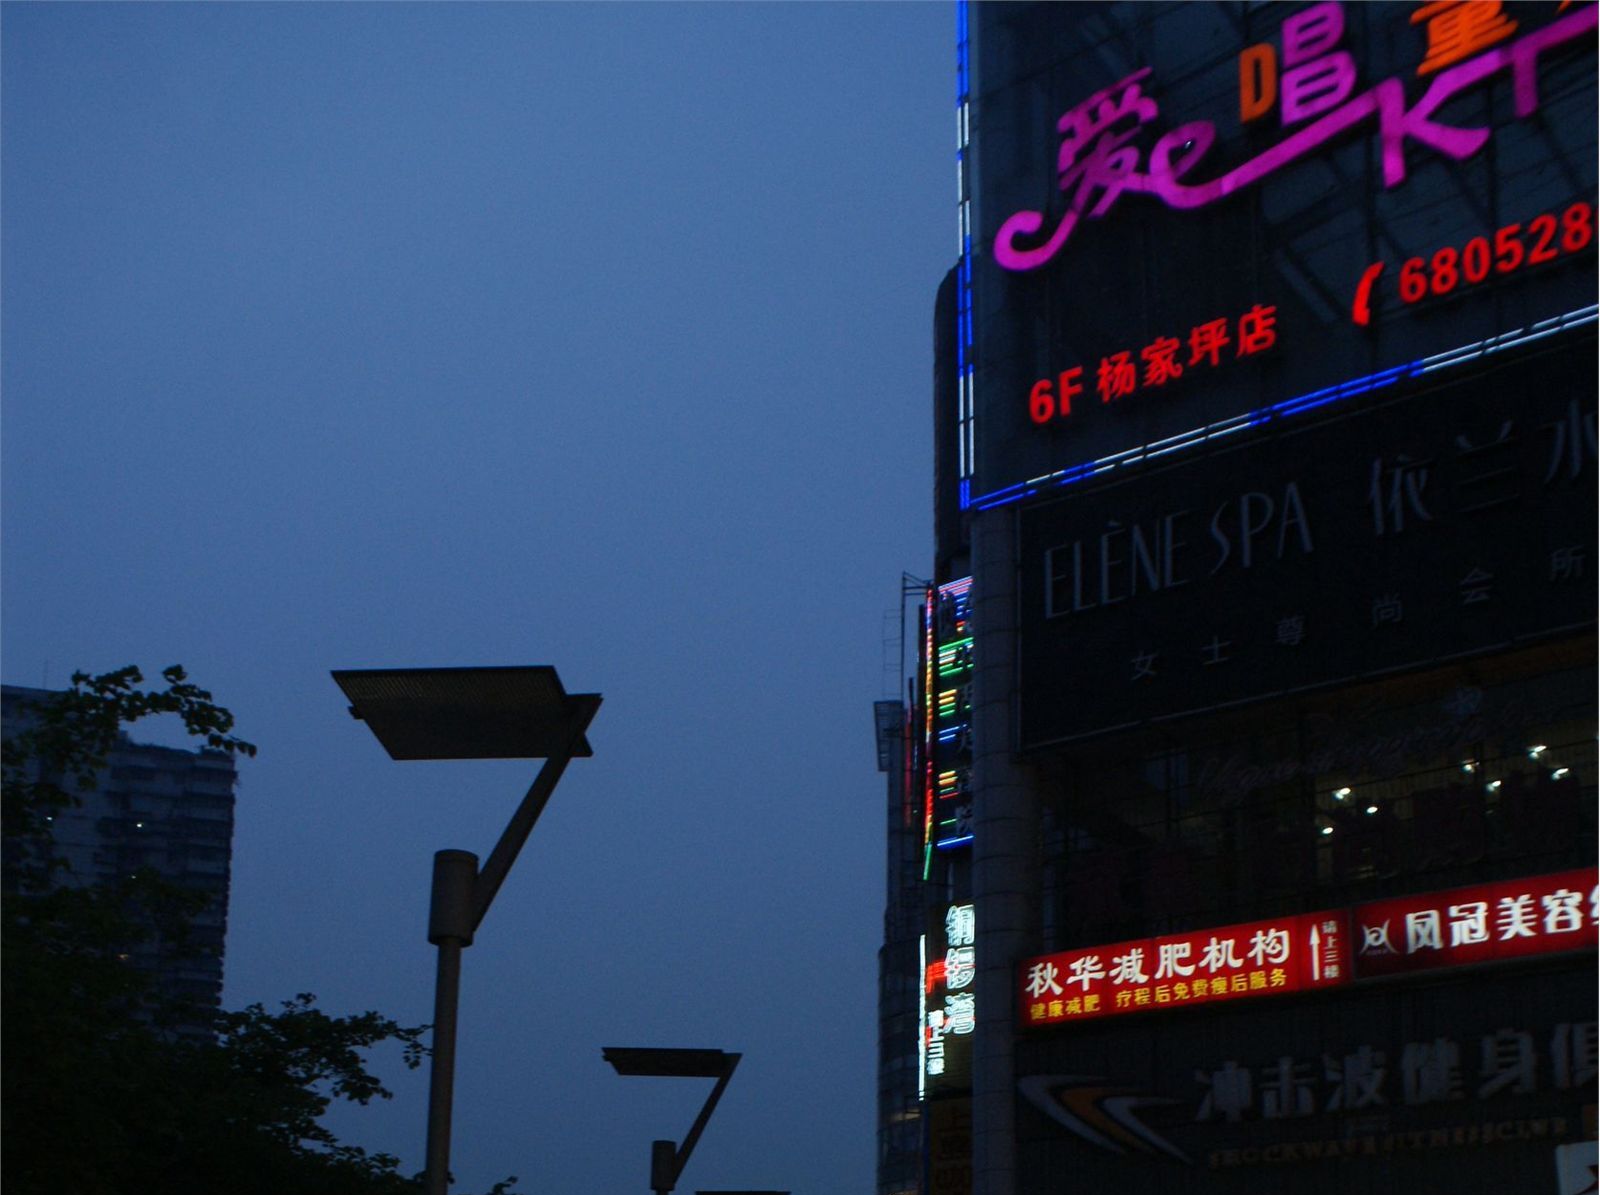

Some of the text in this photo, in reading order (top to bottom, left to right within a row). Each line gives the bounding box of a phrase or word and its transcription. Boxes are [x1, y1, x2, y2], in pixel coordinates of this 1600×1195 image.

[1399, 201, 1598, 305] 680528
[1029, 303, 1278, 425] 6F 杨家坪店
[1208, 480, 1315, 577] SPA
[1025, 927, 1291, 999] 秋华减肥机构
[1030, 994, 1101, 1021] 健康减肥
